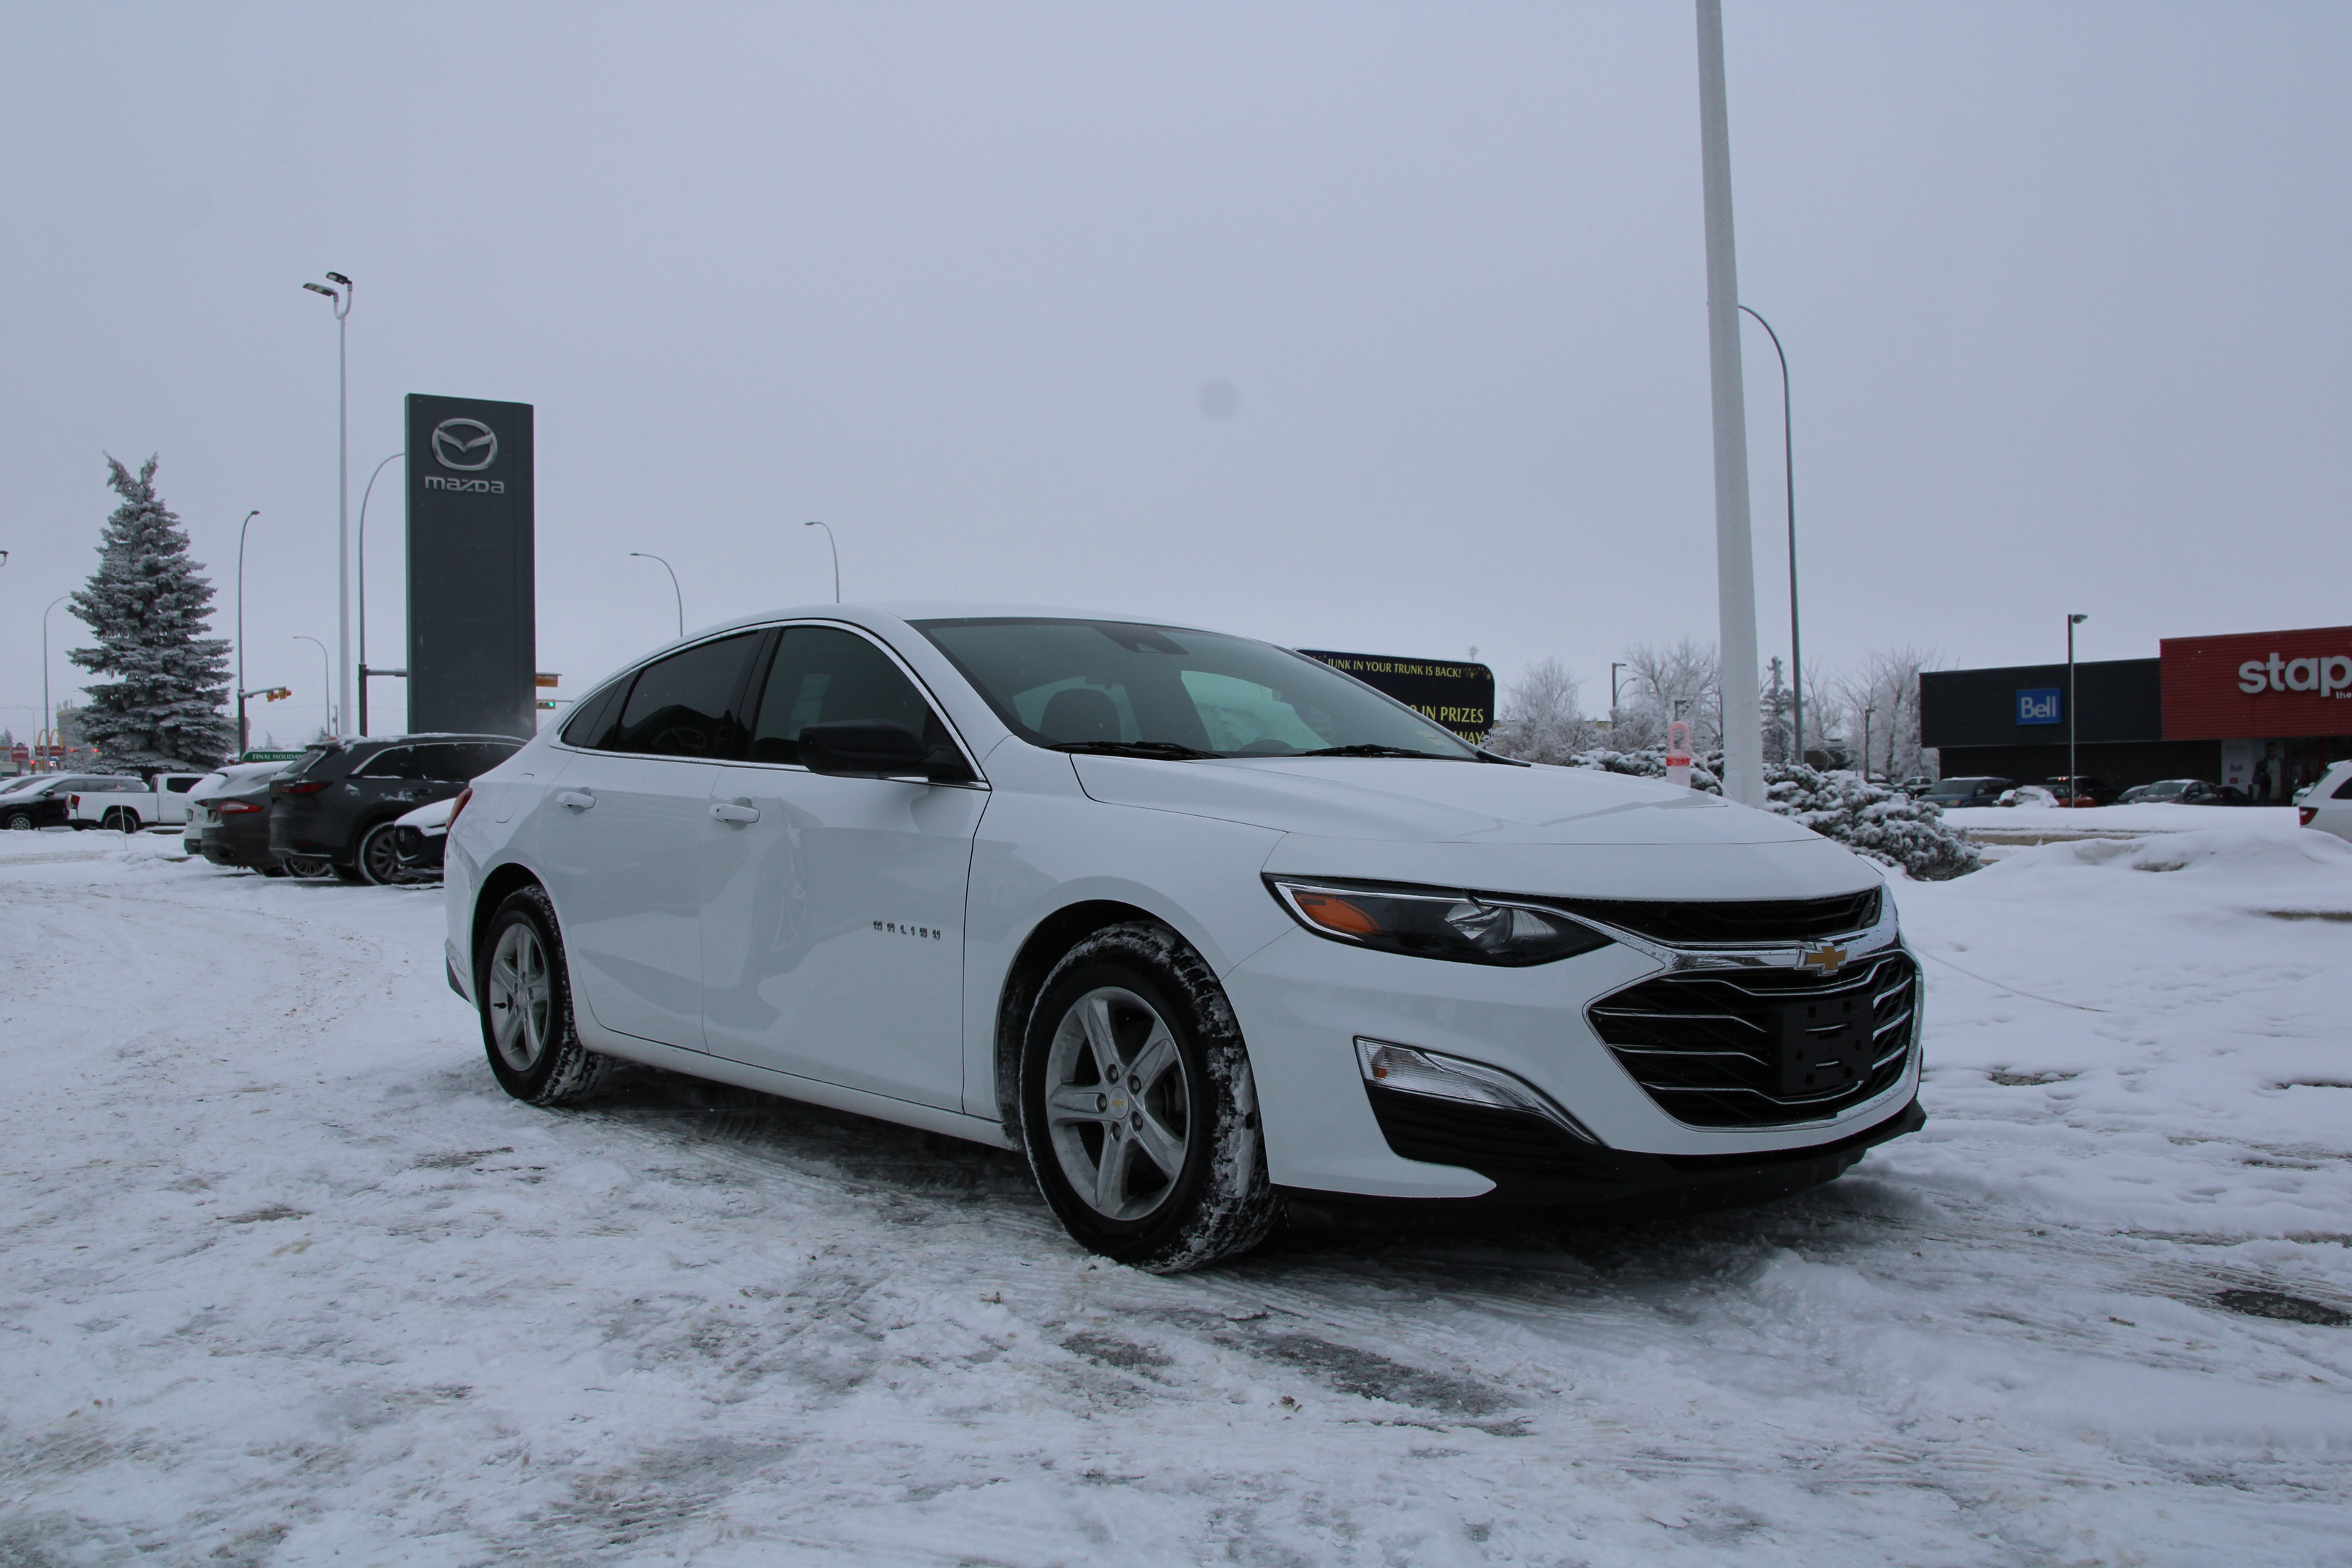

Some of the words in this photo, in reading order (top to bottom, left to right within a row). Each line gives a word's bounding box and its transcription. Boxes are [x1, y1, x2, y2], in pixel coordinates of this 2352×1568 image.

[1353, 660, 1364, 671] IN
[1365, 661, 1392, 673] YOUR
[1394, 663, 1424, 675] TRUNK
[1425, 666, 1433, 676] IS
[1435, 666, 1461, 678] BACK!
[2238, 652, 2352, 698] stap
[2335, 690, 2352, 700] the
[1421, 705, 1436, 721] IN
[1440, 706, 1484, 724] PRIZES
[2021, 695, 2057, 719] Bell
[873, 920, 941, 941] MALIBU
